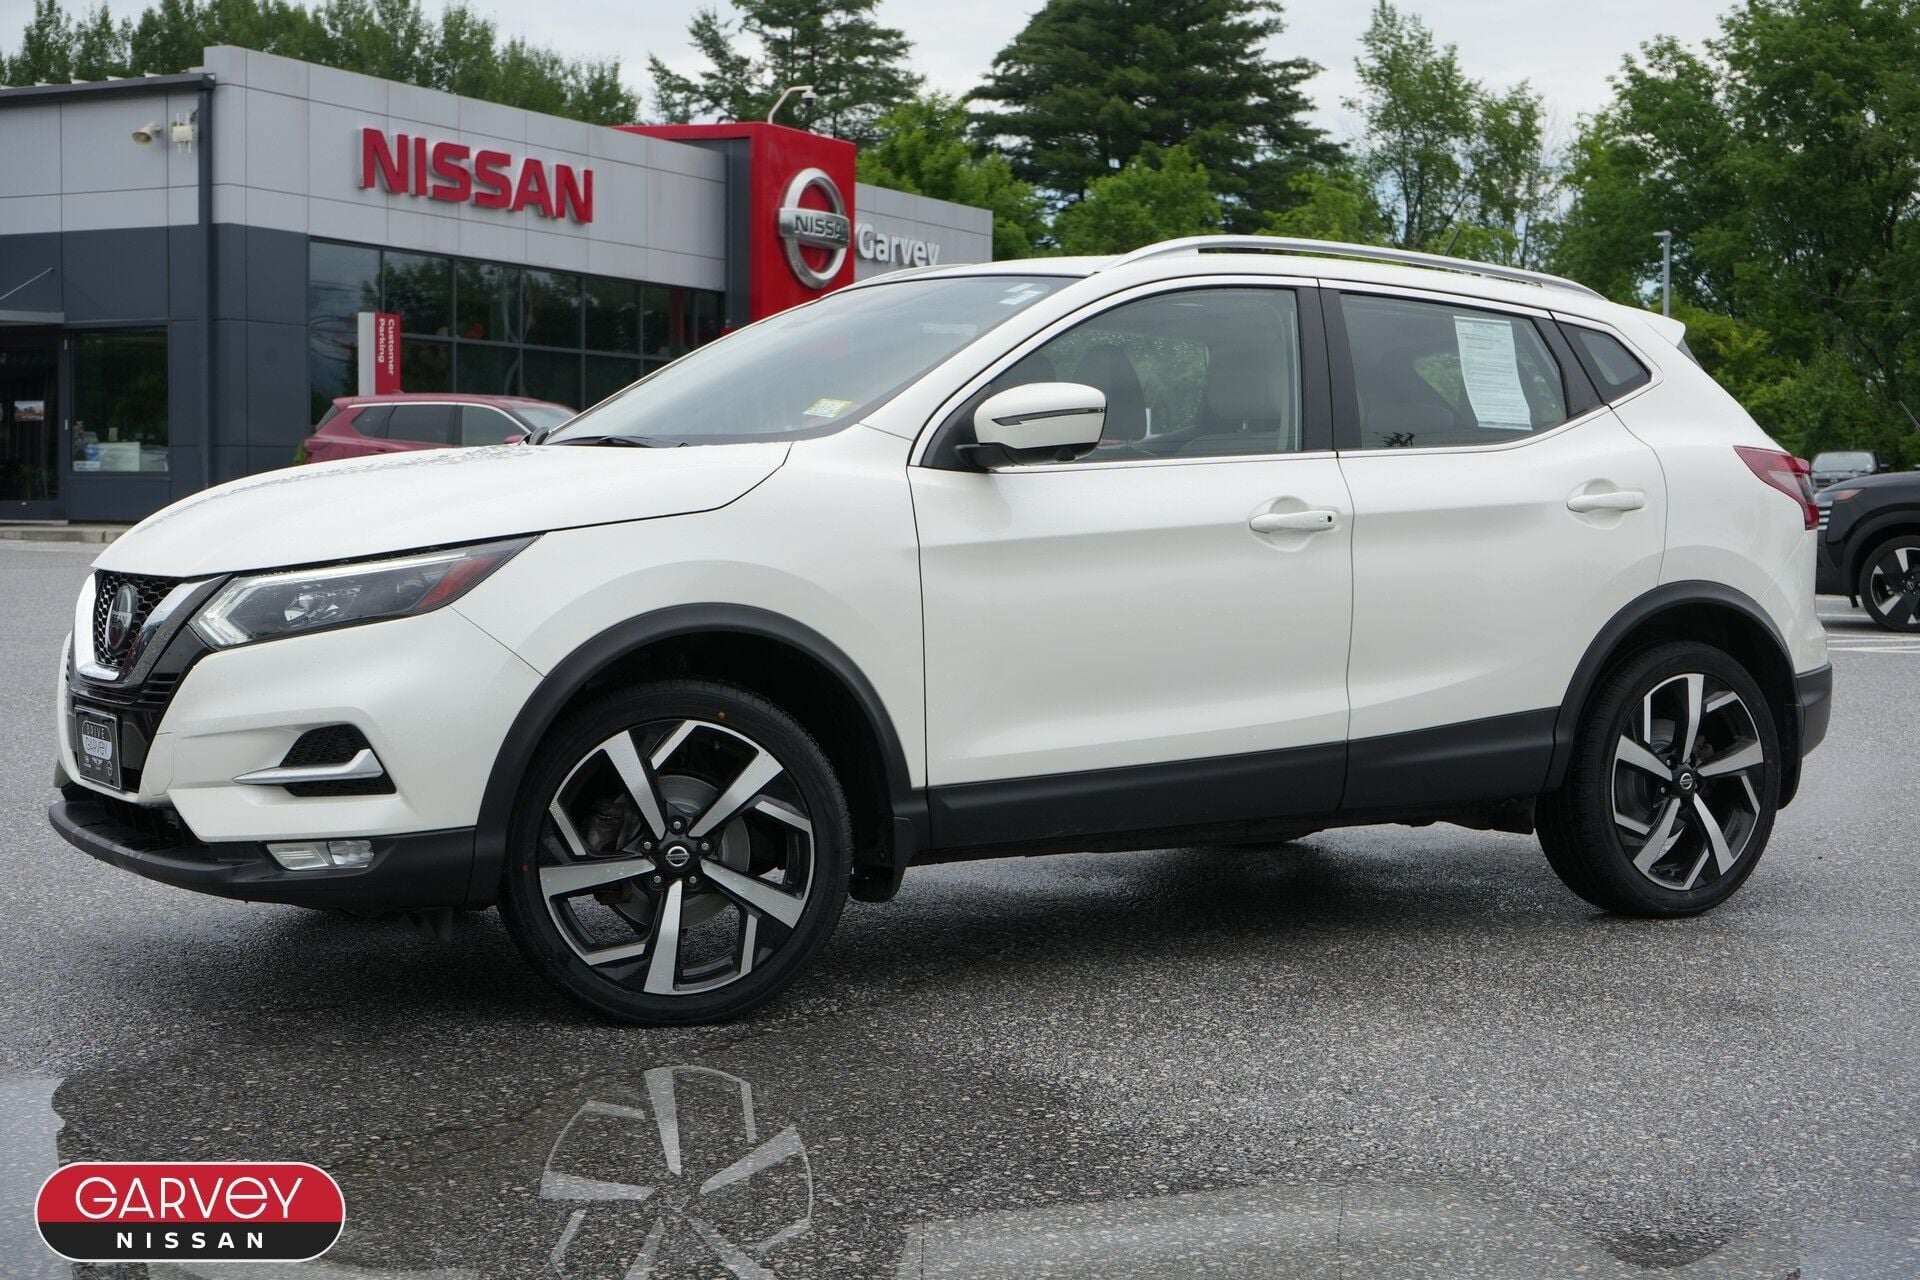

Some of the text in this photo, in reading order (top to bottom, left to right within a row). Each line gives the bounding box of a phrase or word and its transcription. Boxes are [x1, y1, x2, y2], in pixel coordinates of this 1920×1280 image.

[361, 128, 593, 224] NISSAN
[857, 223, 940, 267] Garvey
[377, 317, 386, 364] Parking
[86, 723, 105, 739] DRIVE
